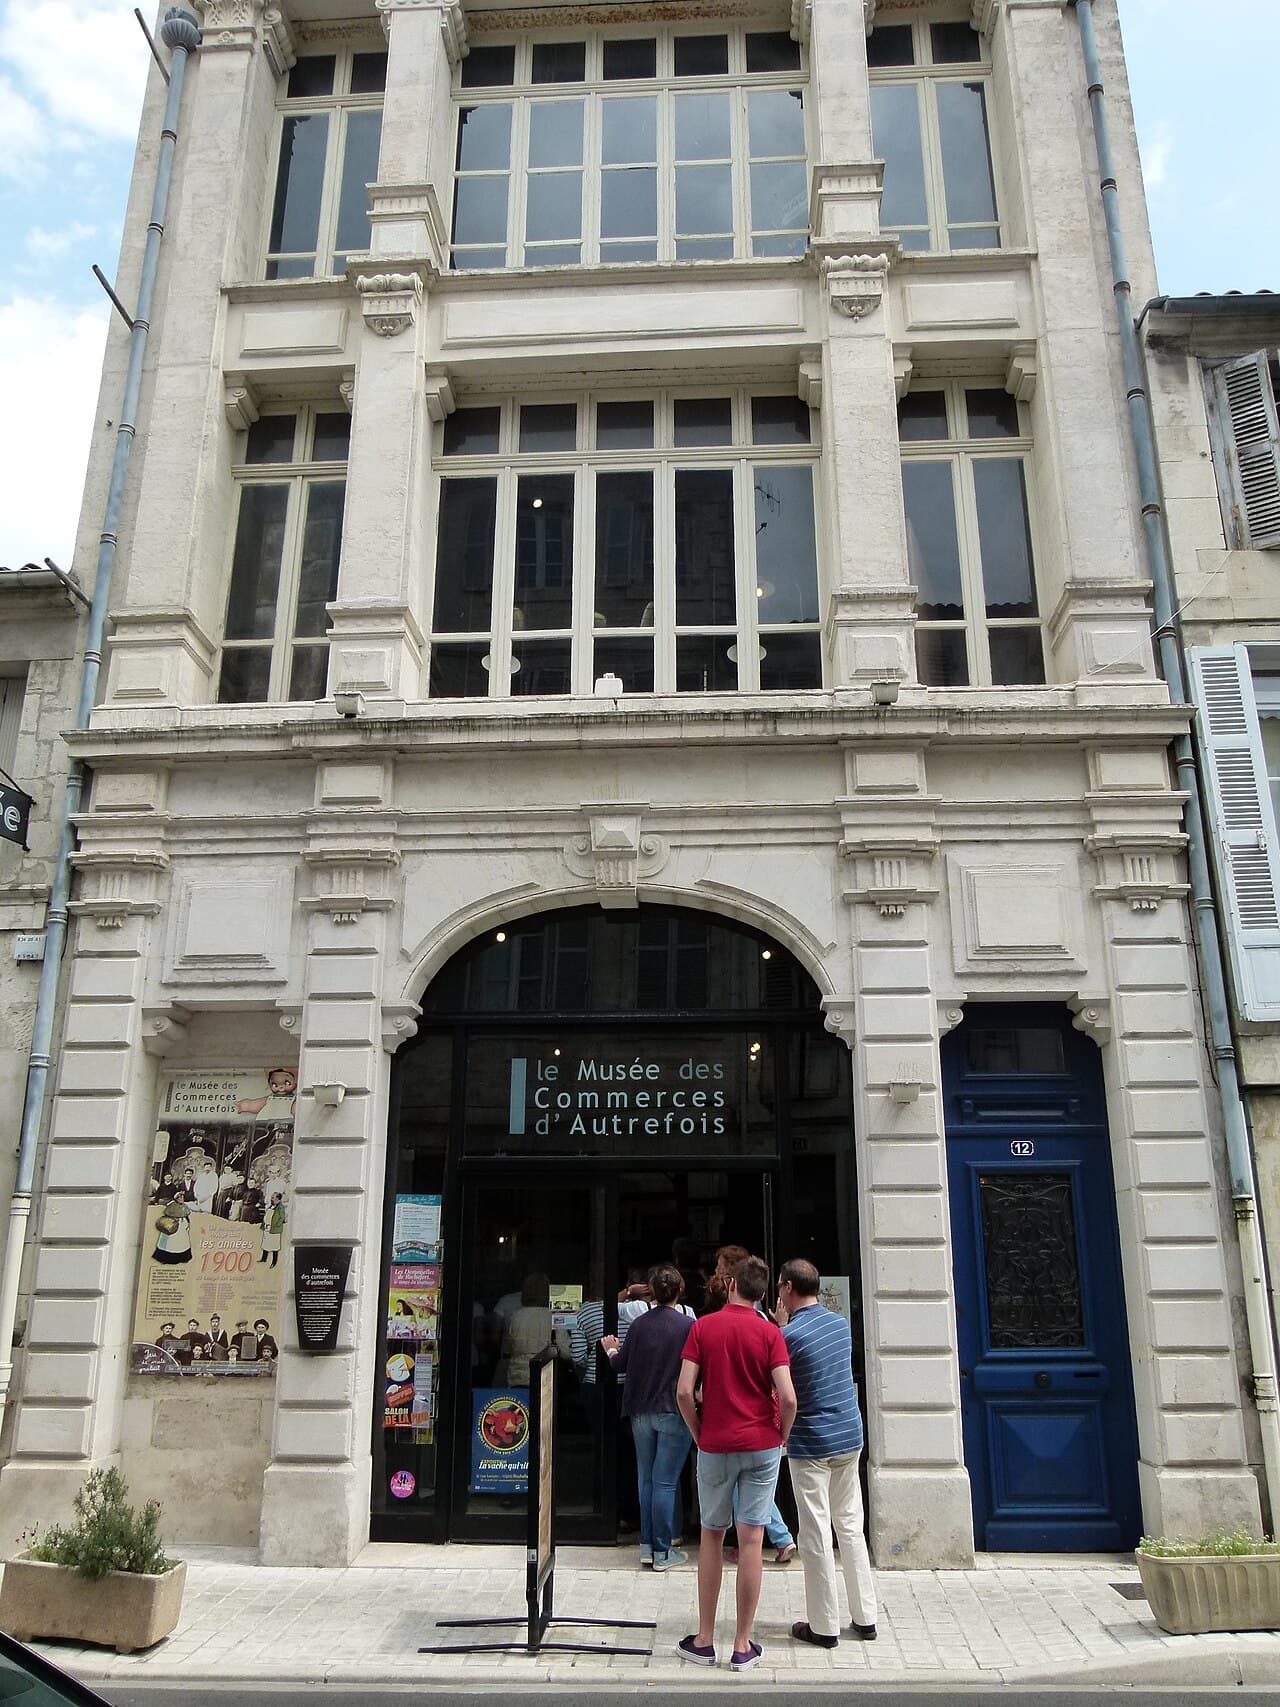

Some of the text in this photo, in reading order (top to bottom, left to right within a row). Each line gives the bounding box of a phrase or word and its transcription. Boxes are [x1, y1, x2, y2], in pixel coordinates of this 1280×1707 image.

[537, 1057, 724, 1081] le Musée des
[177, 1080, 238, 1090] le Musée des
[175, 1092, 237, 1101] Commerces
[534, 1087, 725, 1109] Commerces
[174, 1104, 236, 1113] d'Autrefois
[535, 1112, 725, 1135] d'Autrefois
[1015, 1143, 1030, 1154] 12
[200, 1239, 254, 1250] les années
[200, 1251, 253, 1273] 1900
[385, 1407, 409, 1415] SALON
[385, 1415, 397, 1425] DE
[398, 1414, 409, 1424] LA
[487, 1462, 508, 1470] vache
[508, 1461, 520, 1471] qui
